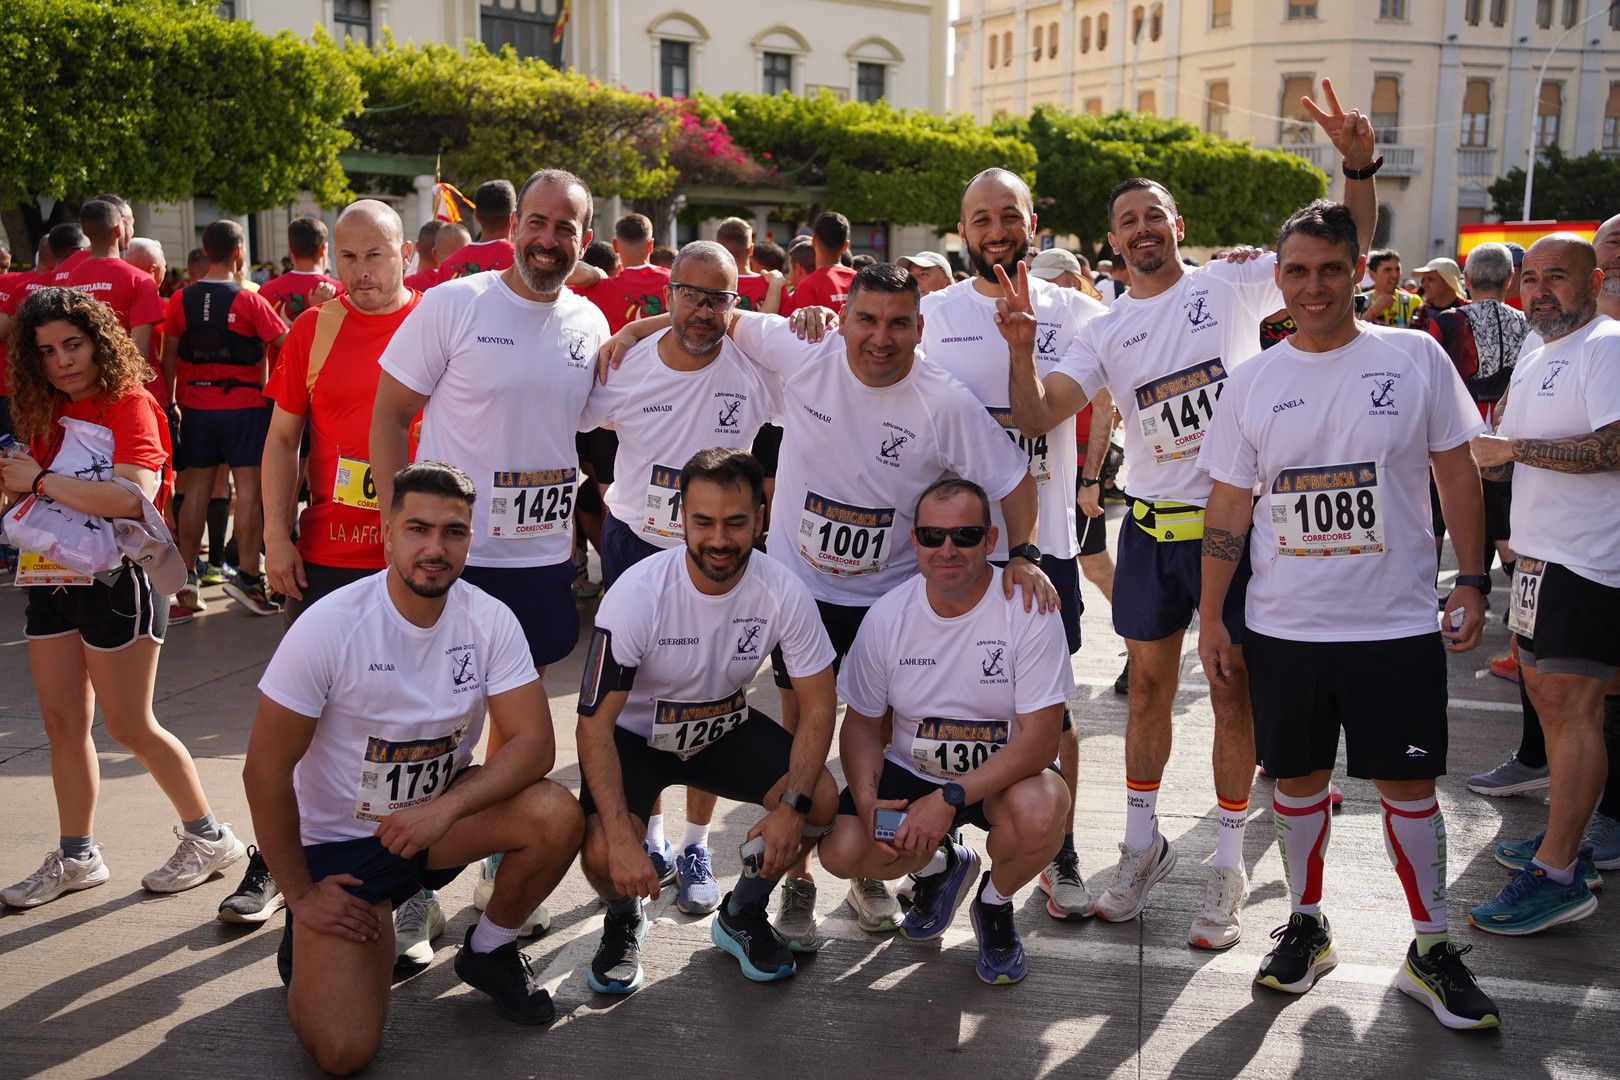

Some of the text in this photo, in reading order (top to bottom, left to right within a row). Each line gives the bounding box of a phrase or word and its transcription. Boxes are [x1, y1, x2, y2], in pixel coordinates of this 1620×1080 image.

[1206, 320, 1218, 328] MAR
[477, 336, 514, 345] MONTOYA
[941, 335, 983, 343] ABDERRAHMAN
[1361, 371, 1401, 379] Africana 2025
[643, 405, 673, 413] HAMADI
[1272, 398, 1305, 413] CANELA
[881, 421, 903, 432] Africana
[1276, 471, 1355, 491] LA AFRICANA
[357, 500, 380, 509] CORRE
[514, 485, 573, 524] 1425
[1294, 489, 1376, 533] 1088
[809, 498, 877, 527] LA AFRICANA
[330, 522, 346, 542] LA
[516, 522, 553, 532] CORREDORES
[818, 521, 885, 560] 1001
[1302, 532, 1352, 542] CORREDORES
[818, 552, 861, 566] CORREDORES
[659, 637, 699, 646] GUERRERO
[900, 658, 936, 666] LAHUERTA
[661, 703, 676, 723] LA
[921, 722, 992, 740] LA AFRICANA
[371, 743, 387, 762] LA
[386, 753, 453, 800] 1731
[388, 794, 432, 809] CORREDORES
